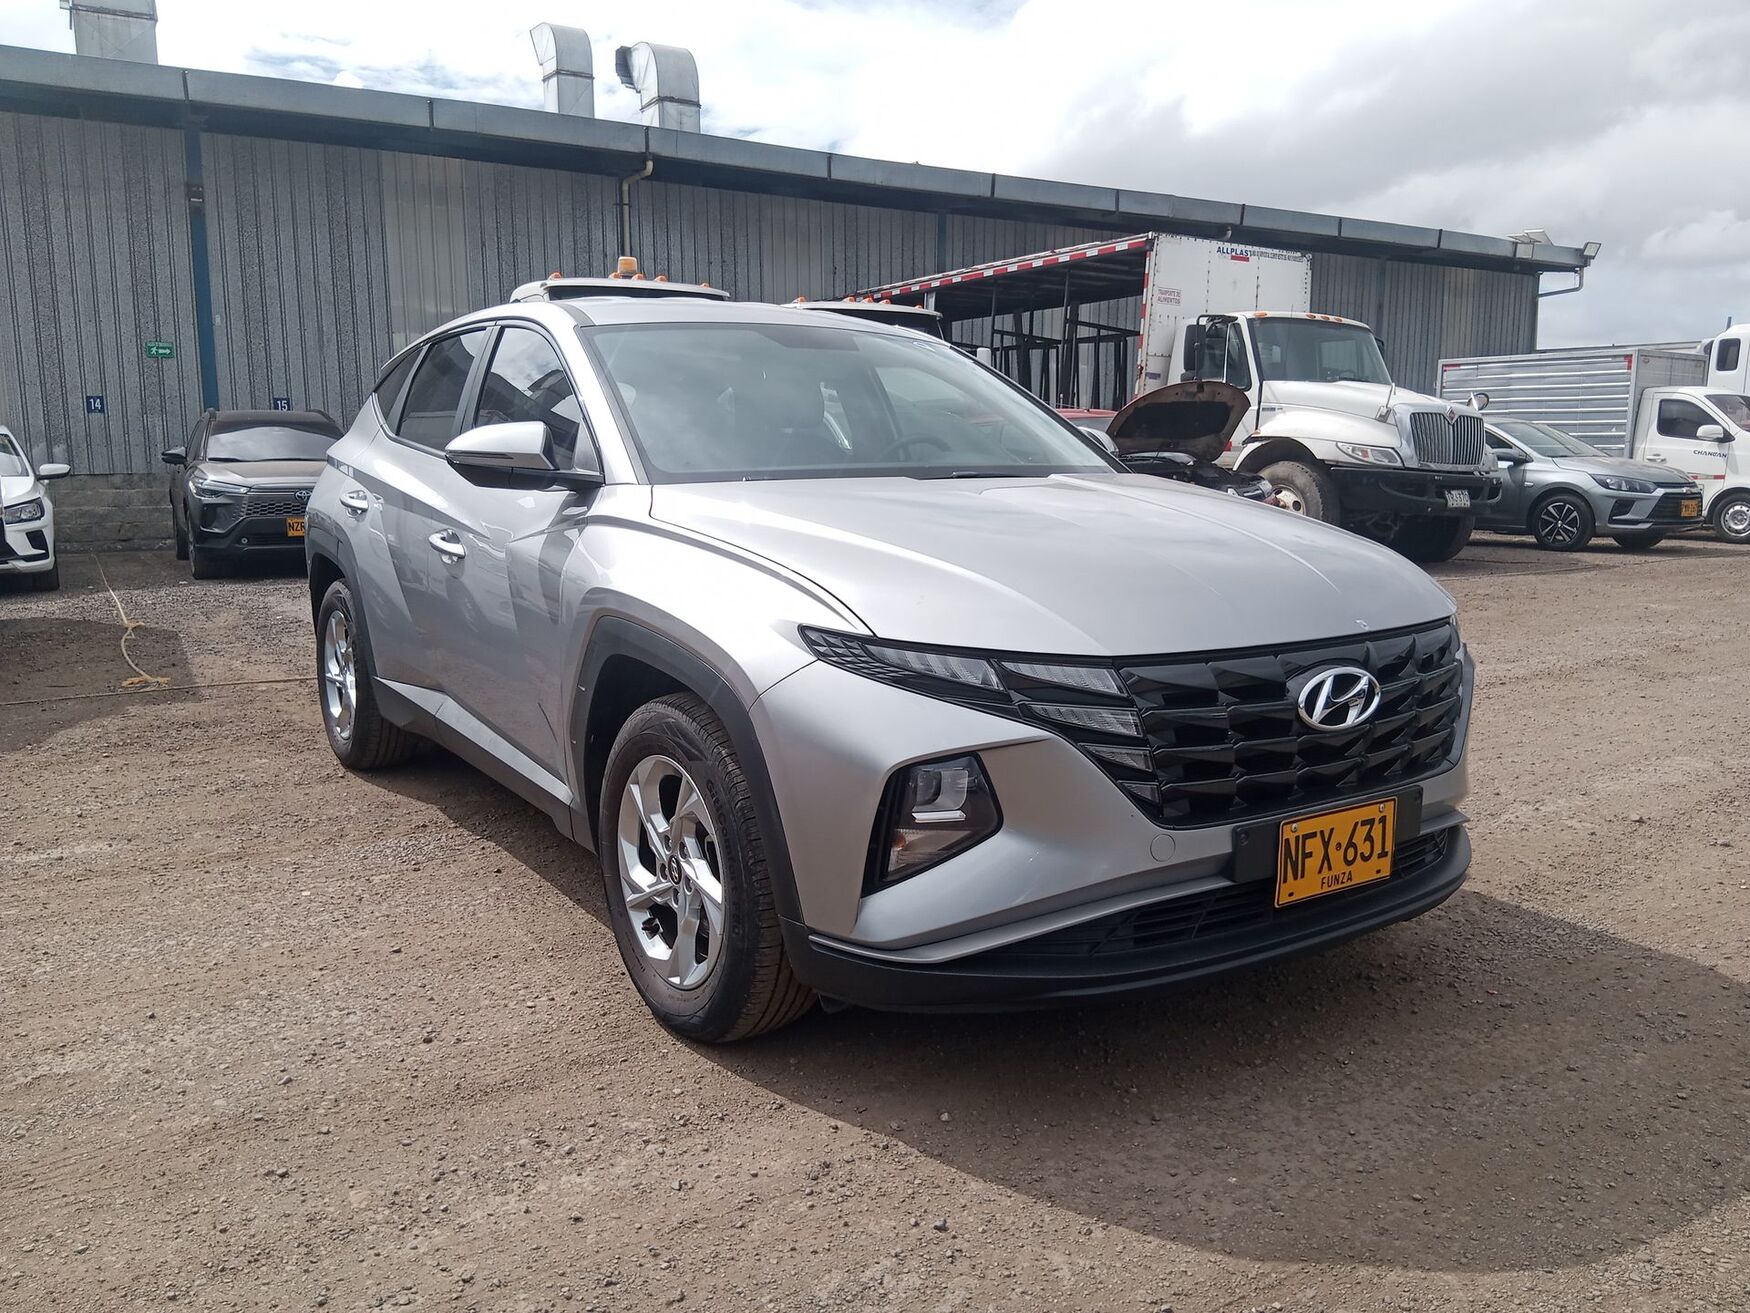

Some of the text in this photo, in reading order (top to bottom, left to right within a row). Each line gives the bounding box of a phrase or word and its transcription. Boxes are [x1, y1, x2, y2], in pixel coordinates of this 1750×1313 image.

[89, 398, 101, 410] 14
[277, 400, 288, 411] 15
[1320, 870, 1353, 890] FUNZA
